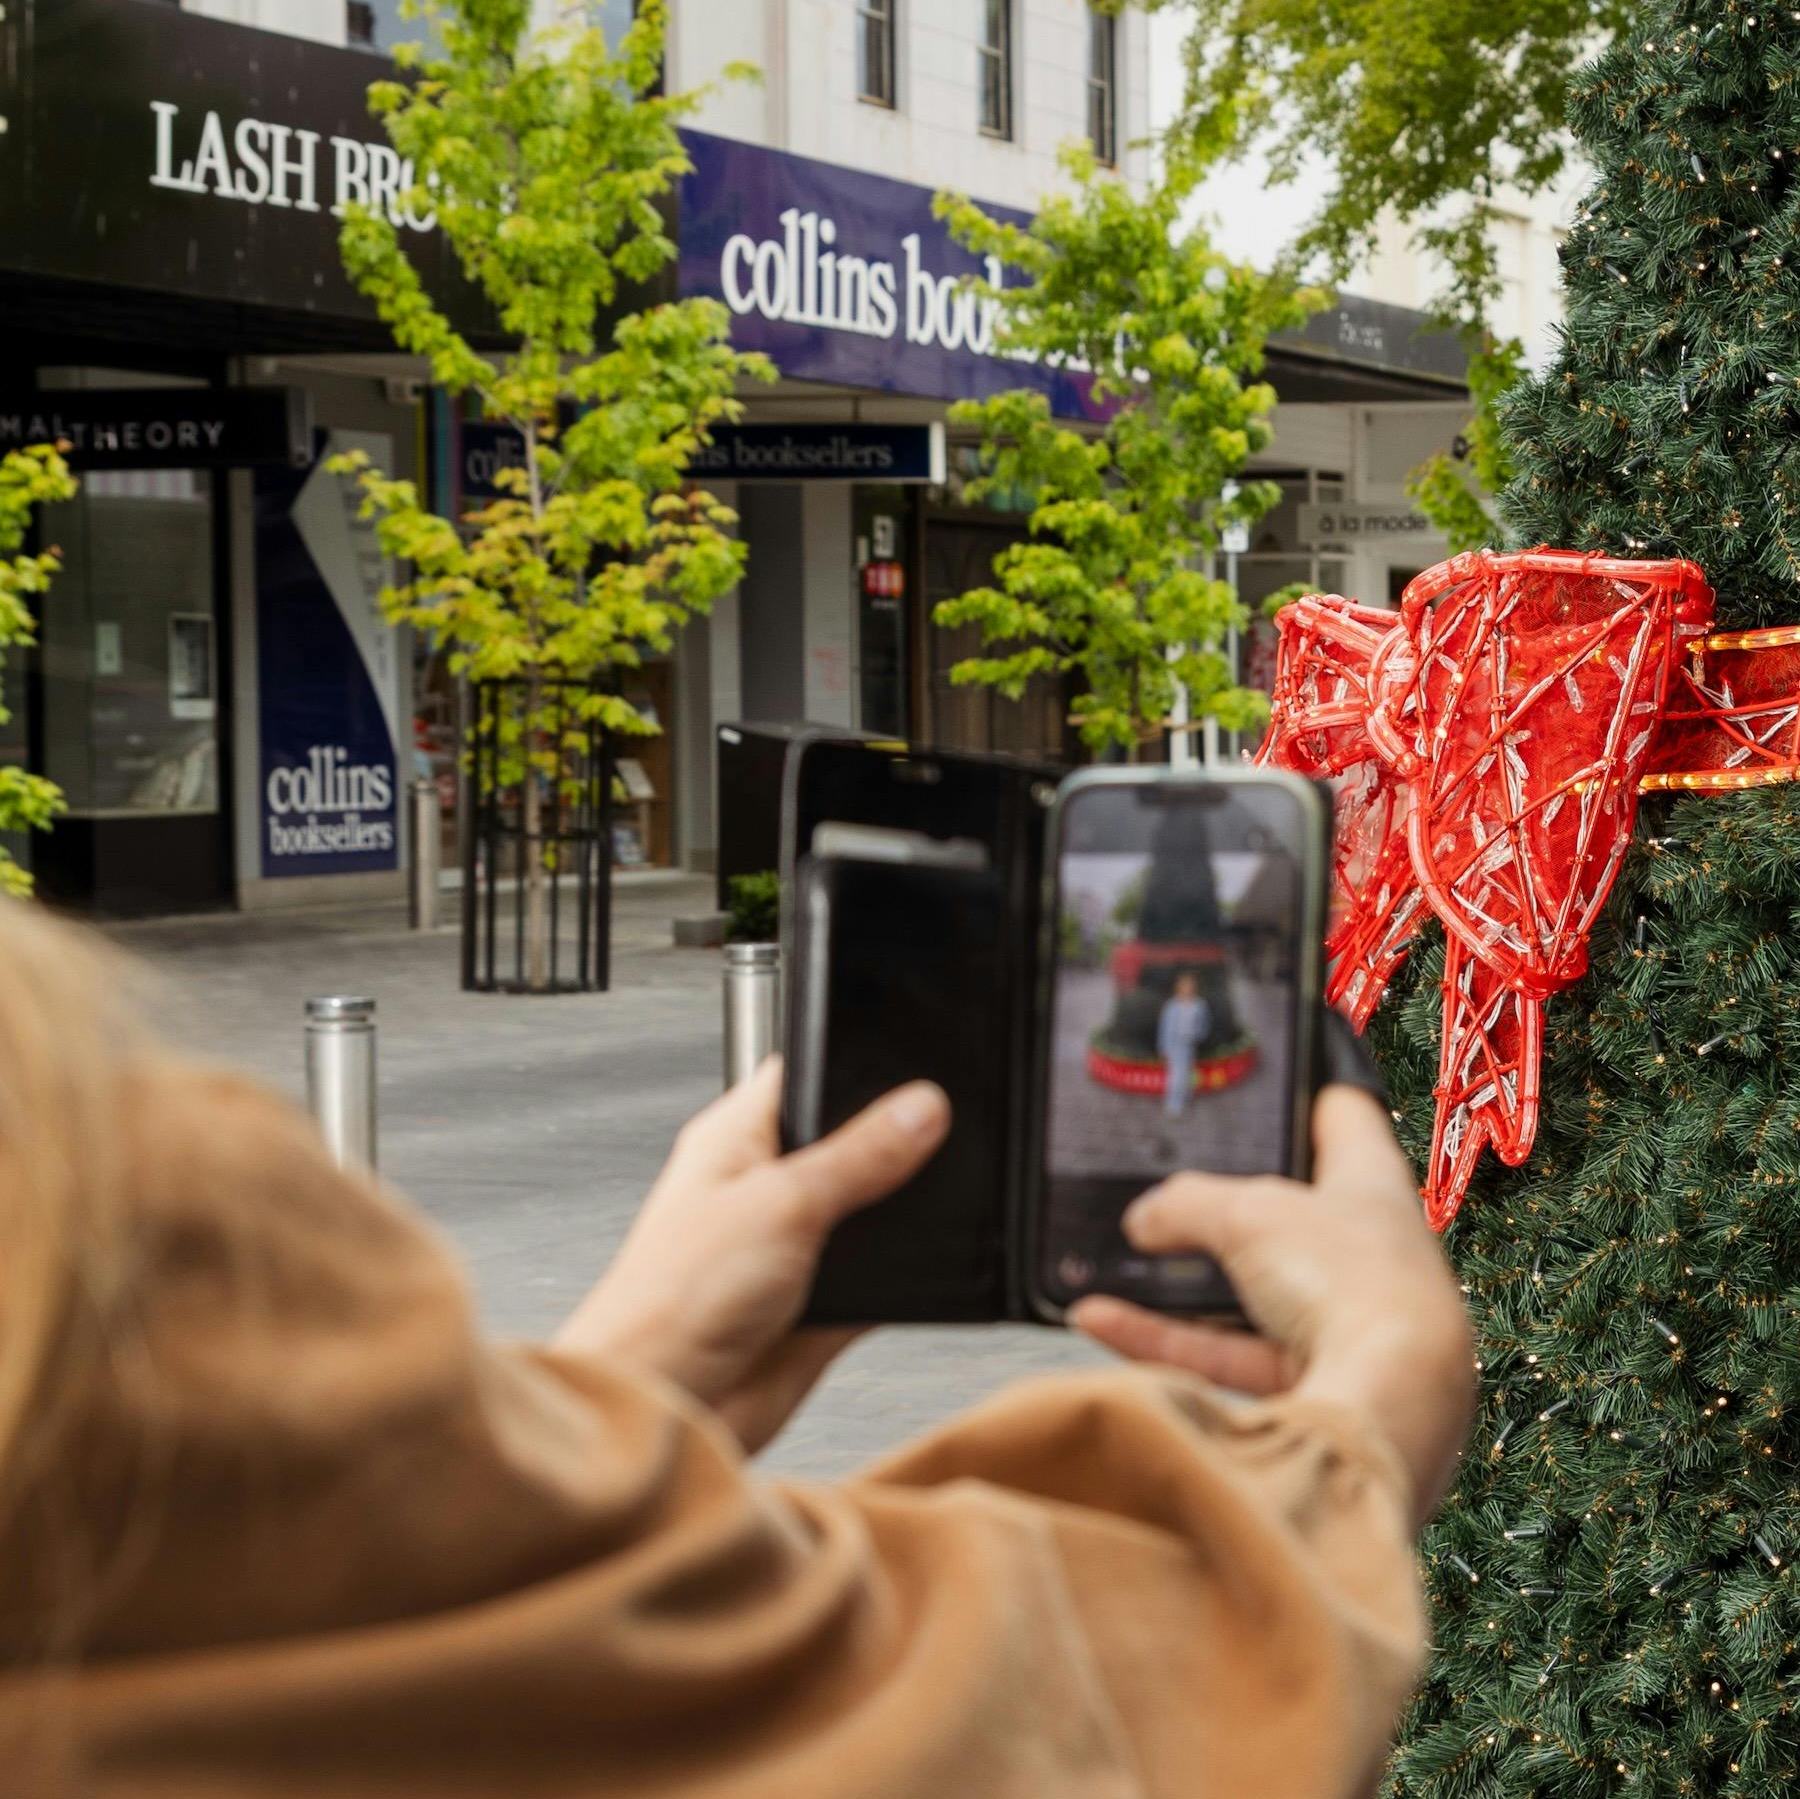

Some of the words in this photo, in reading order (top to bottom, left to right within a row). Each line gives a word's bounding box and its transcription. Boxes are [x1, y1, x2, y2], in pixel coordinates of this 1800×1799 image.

[150, 100, 320, 212] LASH
[721, 208, 897, 338] collins
[70, 421, 225, 451] THEORY
[735, 436, 895, 469] booksellers
[1342, 515, 1359, 532] la
[1367, 514, 1427, 531] mode
[267, 744, 392, 814] collins
[269, 814, 393, 855] booksellers
